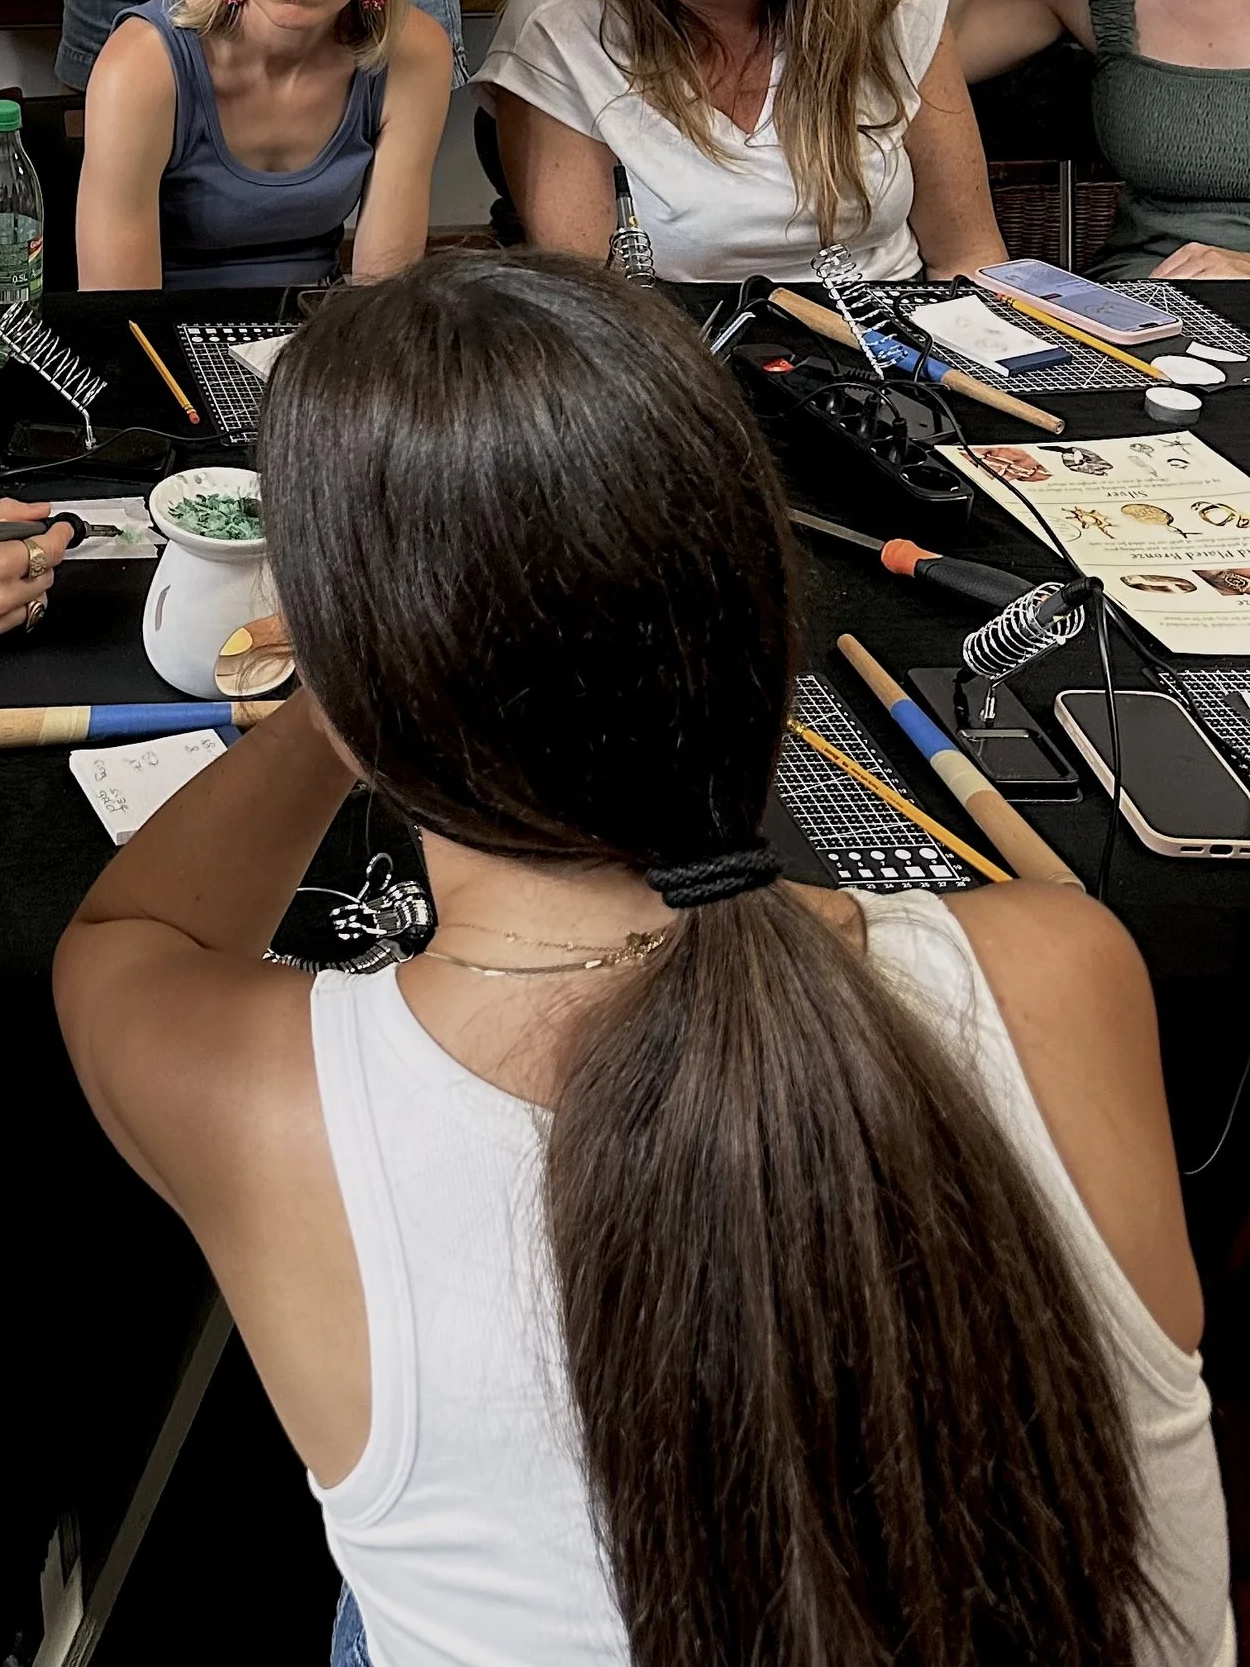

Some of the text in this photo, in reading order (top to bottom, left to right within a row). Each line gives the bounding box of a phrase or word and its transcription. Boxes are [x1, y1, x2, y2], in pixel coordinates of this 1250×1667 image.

[1105, 489, 1149, 500] Silver
[1130, 551, 1183, 561] Bronze
[1184, 549, 1234, 561] Plated
